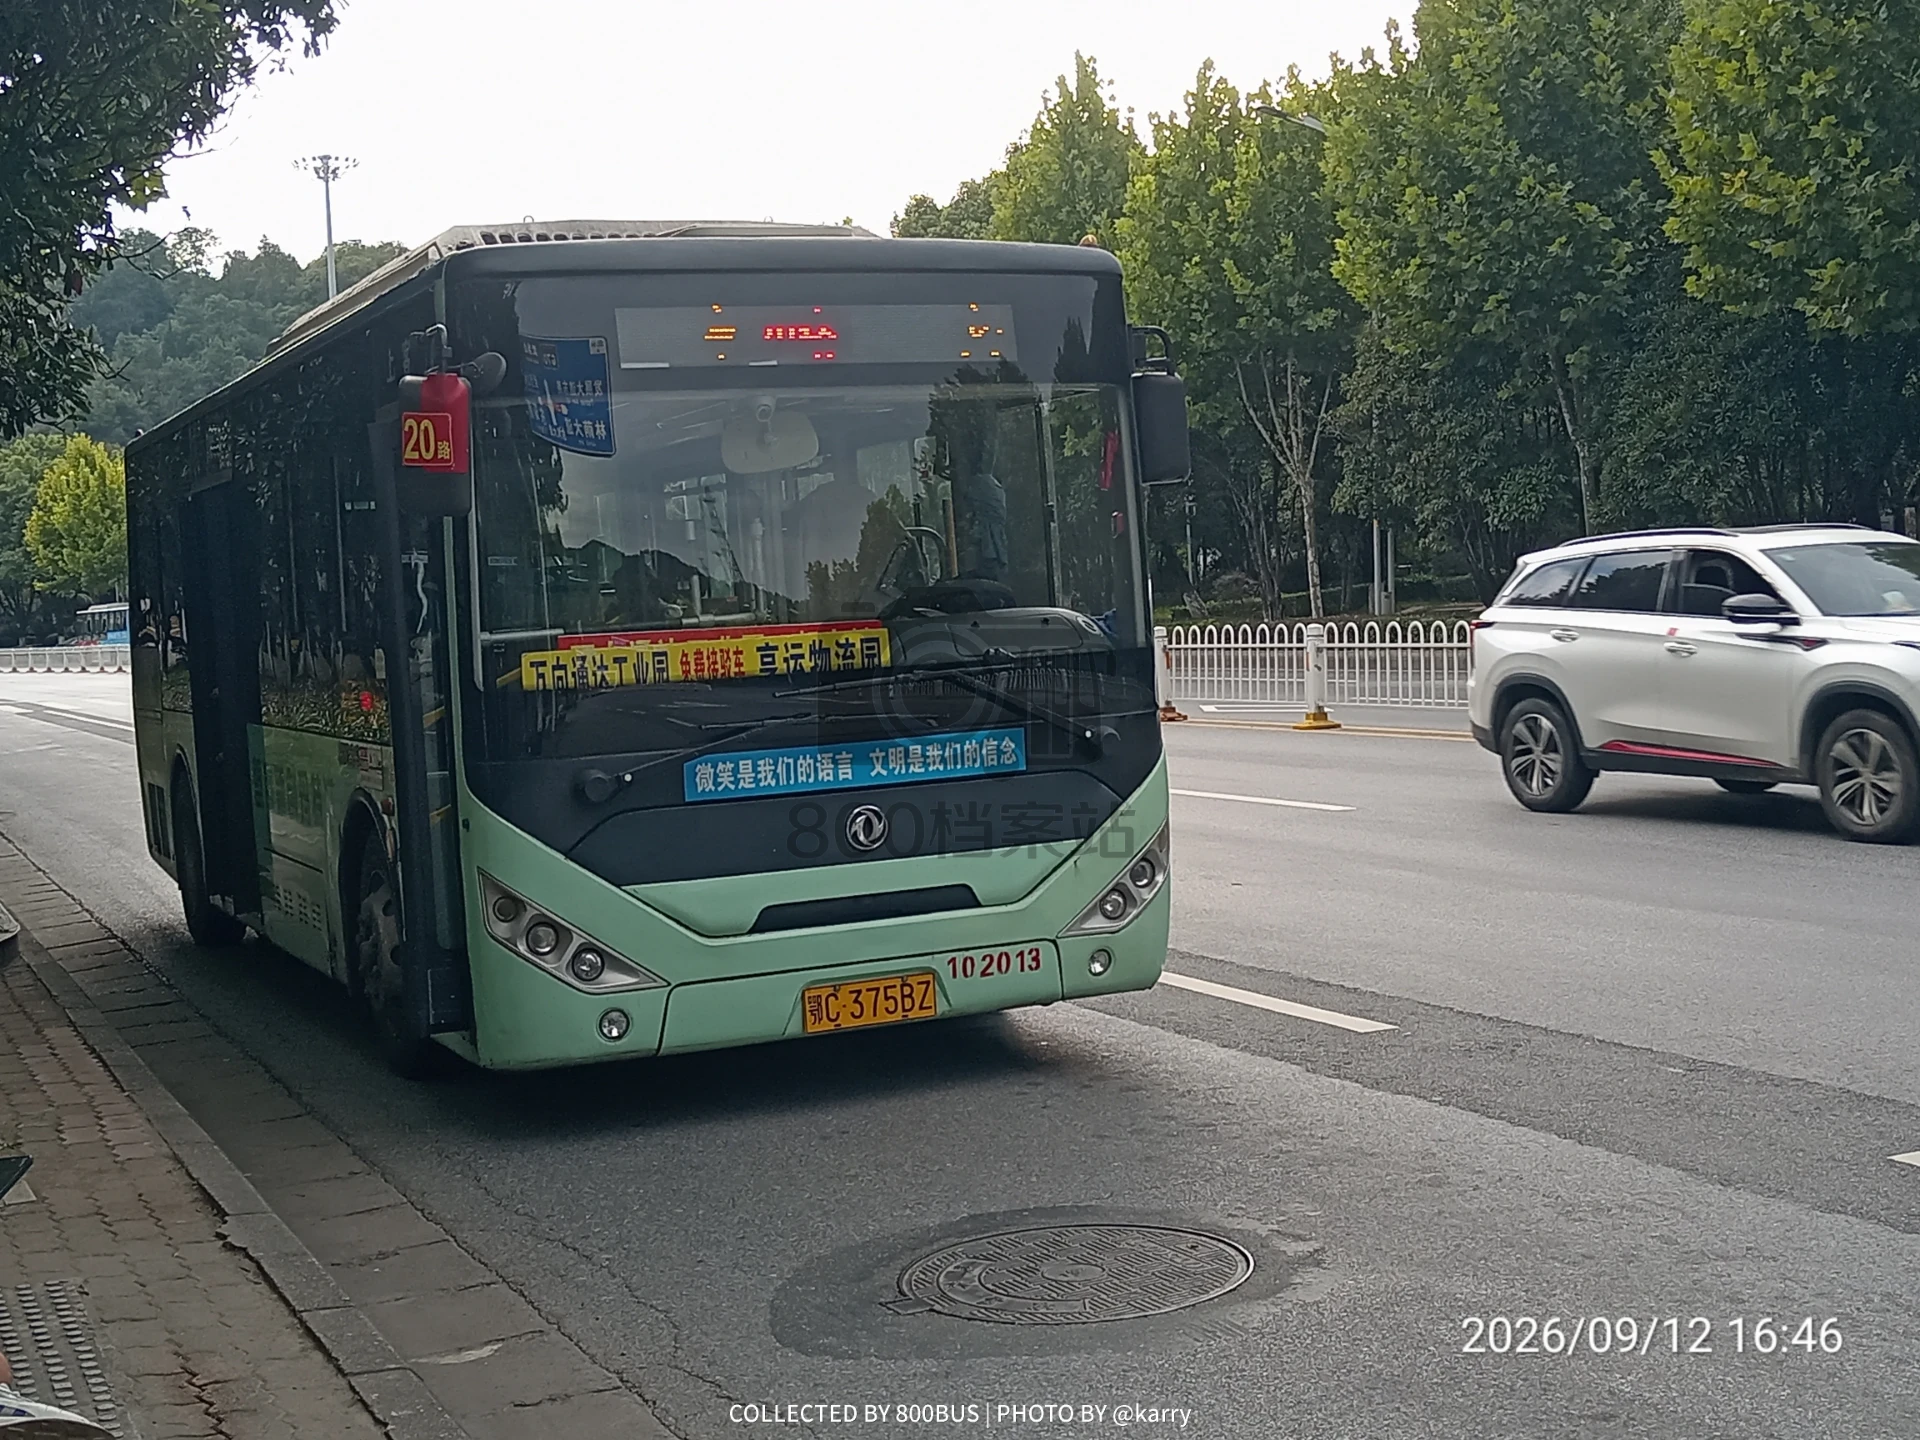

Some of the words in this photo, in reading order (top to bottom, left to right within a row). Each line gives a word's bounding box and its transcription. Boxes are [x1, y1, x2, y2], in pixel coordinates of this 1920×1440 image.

[403, 417, 451, 460] 20路
[528, 650, 670, 691] 万向通达工业园
[679, 646, 746, 680] 免费接驳车
[694, 752, 854, 794] 微笑是我们的语言
[869, 736, 1018, 778] 文明是我们的信念
[946, 947, 1042, 980] 102013
